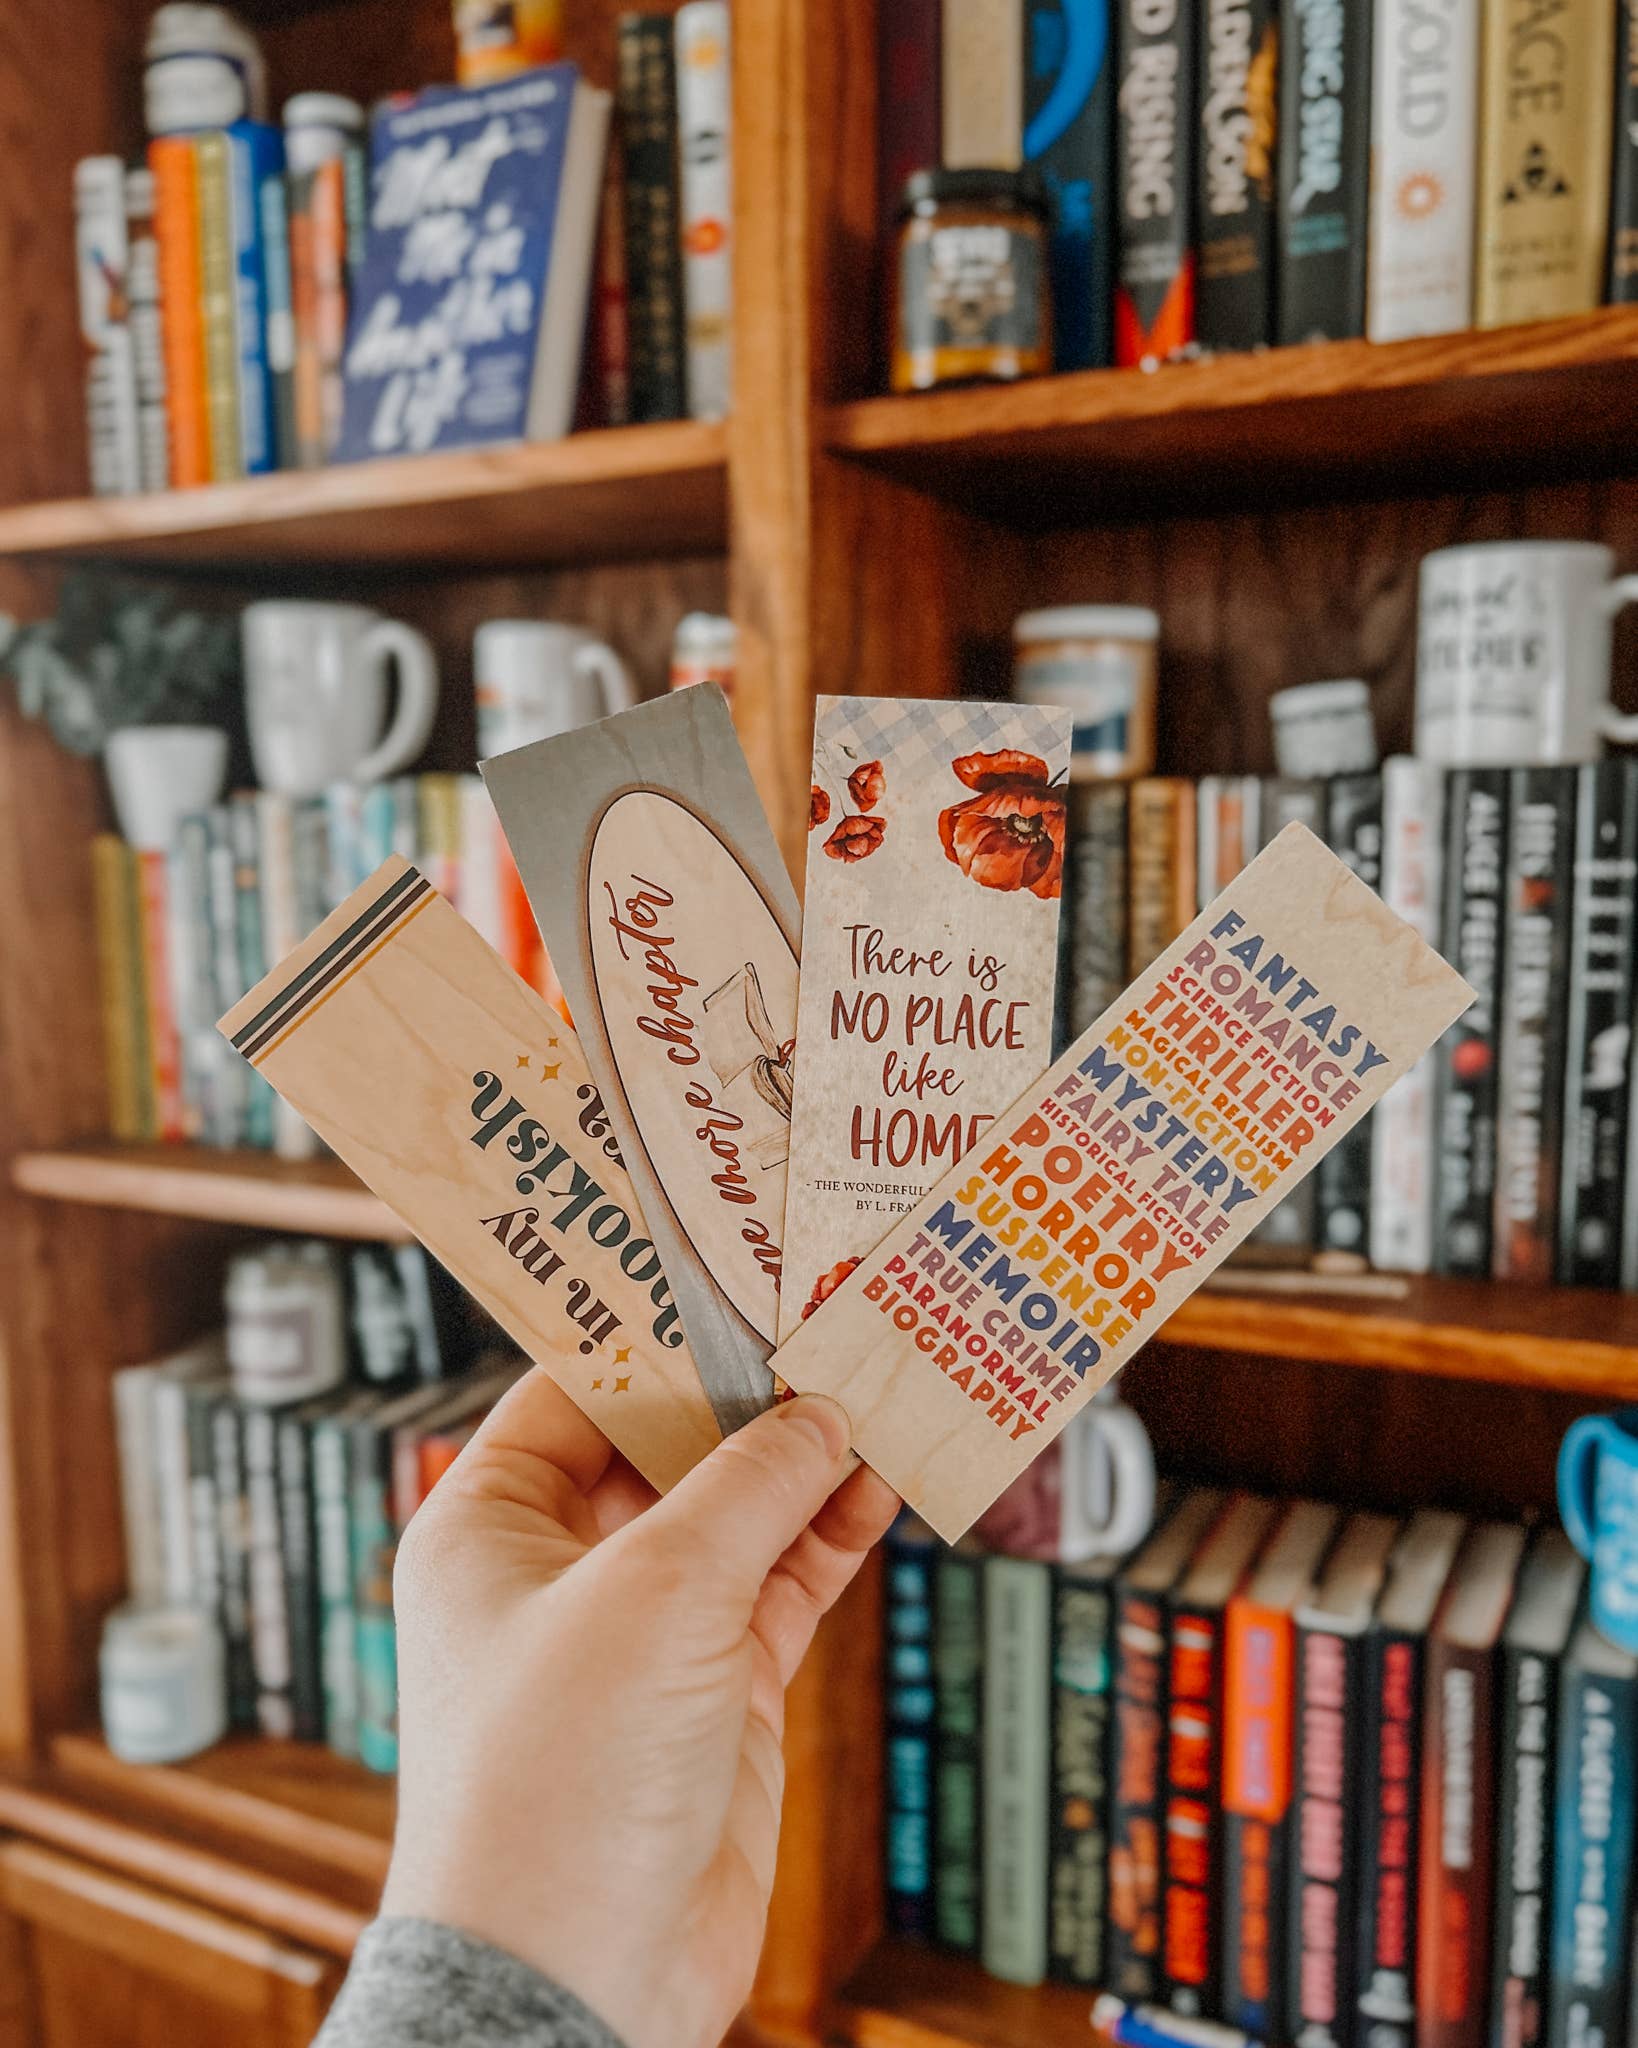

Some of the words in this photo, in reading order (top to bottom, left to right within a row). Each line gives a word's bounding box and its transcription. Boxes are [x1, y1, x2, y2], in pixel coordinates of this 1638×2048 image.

[1118, 42, 1178, 219] RISING
[1397, 0, 1455, 138] OLD
[1287, 97, 1343, 215] STAR
[603, 874, 699, 1066] chapter
[830, 990, 889, 1044] NO
[905, 993, 1030, 1050] PLACE
[843, 924, 952, 979] There
[968, 948, 1006, 992] is
[1184, 939, 1361, 1111] ROMANCE
[1209, 909, 1390, 1078] FANTASY
[576, 1083, 627, 1171] ra
[882, 1050, 964, 1100] like
[1077, 1045, 1258, 1214] MYSTERY
[1105, 1025, 1279, 1193] NON-FICTION
[1124, 1009, 1211, 1096] MAGICAL
[1211, 1092, 1293, 1172] REALISM
[1144, 982, 1315, 1155] THRILLER
[1167, 966, 1253, 1049] SCIENCE
[1250, 1045, 1336, 1129] FICTION
[470, 1070, 684, 1348] bookish
[685, 1082, 743, 1205] more
[814, 1180, 841, 1192] THE
[843, 1182, 927, 1197] WONDERFUL
[856, 1200, 873, 1211] BY
[875, 1201, 886, 1212] L.
[889, 1203, 917, 1213] FRA
[1009, 1112, 1193, 1283] POETRY
[1040, 1097, 1137, 1194] HISTORICAL
[1137, 1191, 1208, 1260] FICTION
[1053, 1073, 1154, 1167] FAIRY
[1151, 1164, 1230, 1245] TALE
[479, 1207, 566, 1285] my
[741, 1217, 781, 1295] ne
[923, 1200, 1101, 1380] MEMOIR
[954, 1175, 1133, 1348] SUSPENSE
[980, 1143, 1156, 1321] HORROR
[565, 1278, 623, 1355] in
[862, 1274, 1037, 1441] BIOGRAPHY
[883, 1254, 1052, 1423] PARANORMAL
[905, 1231, 983, 1311] TRUE
[982, 1309, 1077, 1402] CRIME
